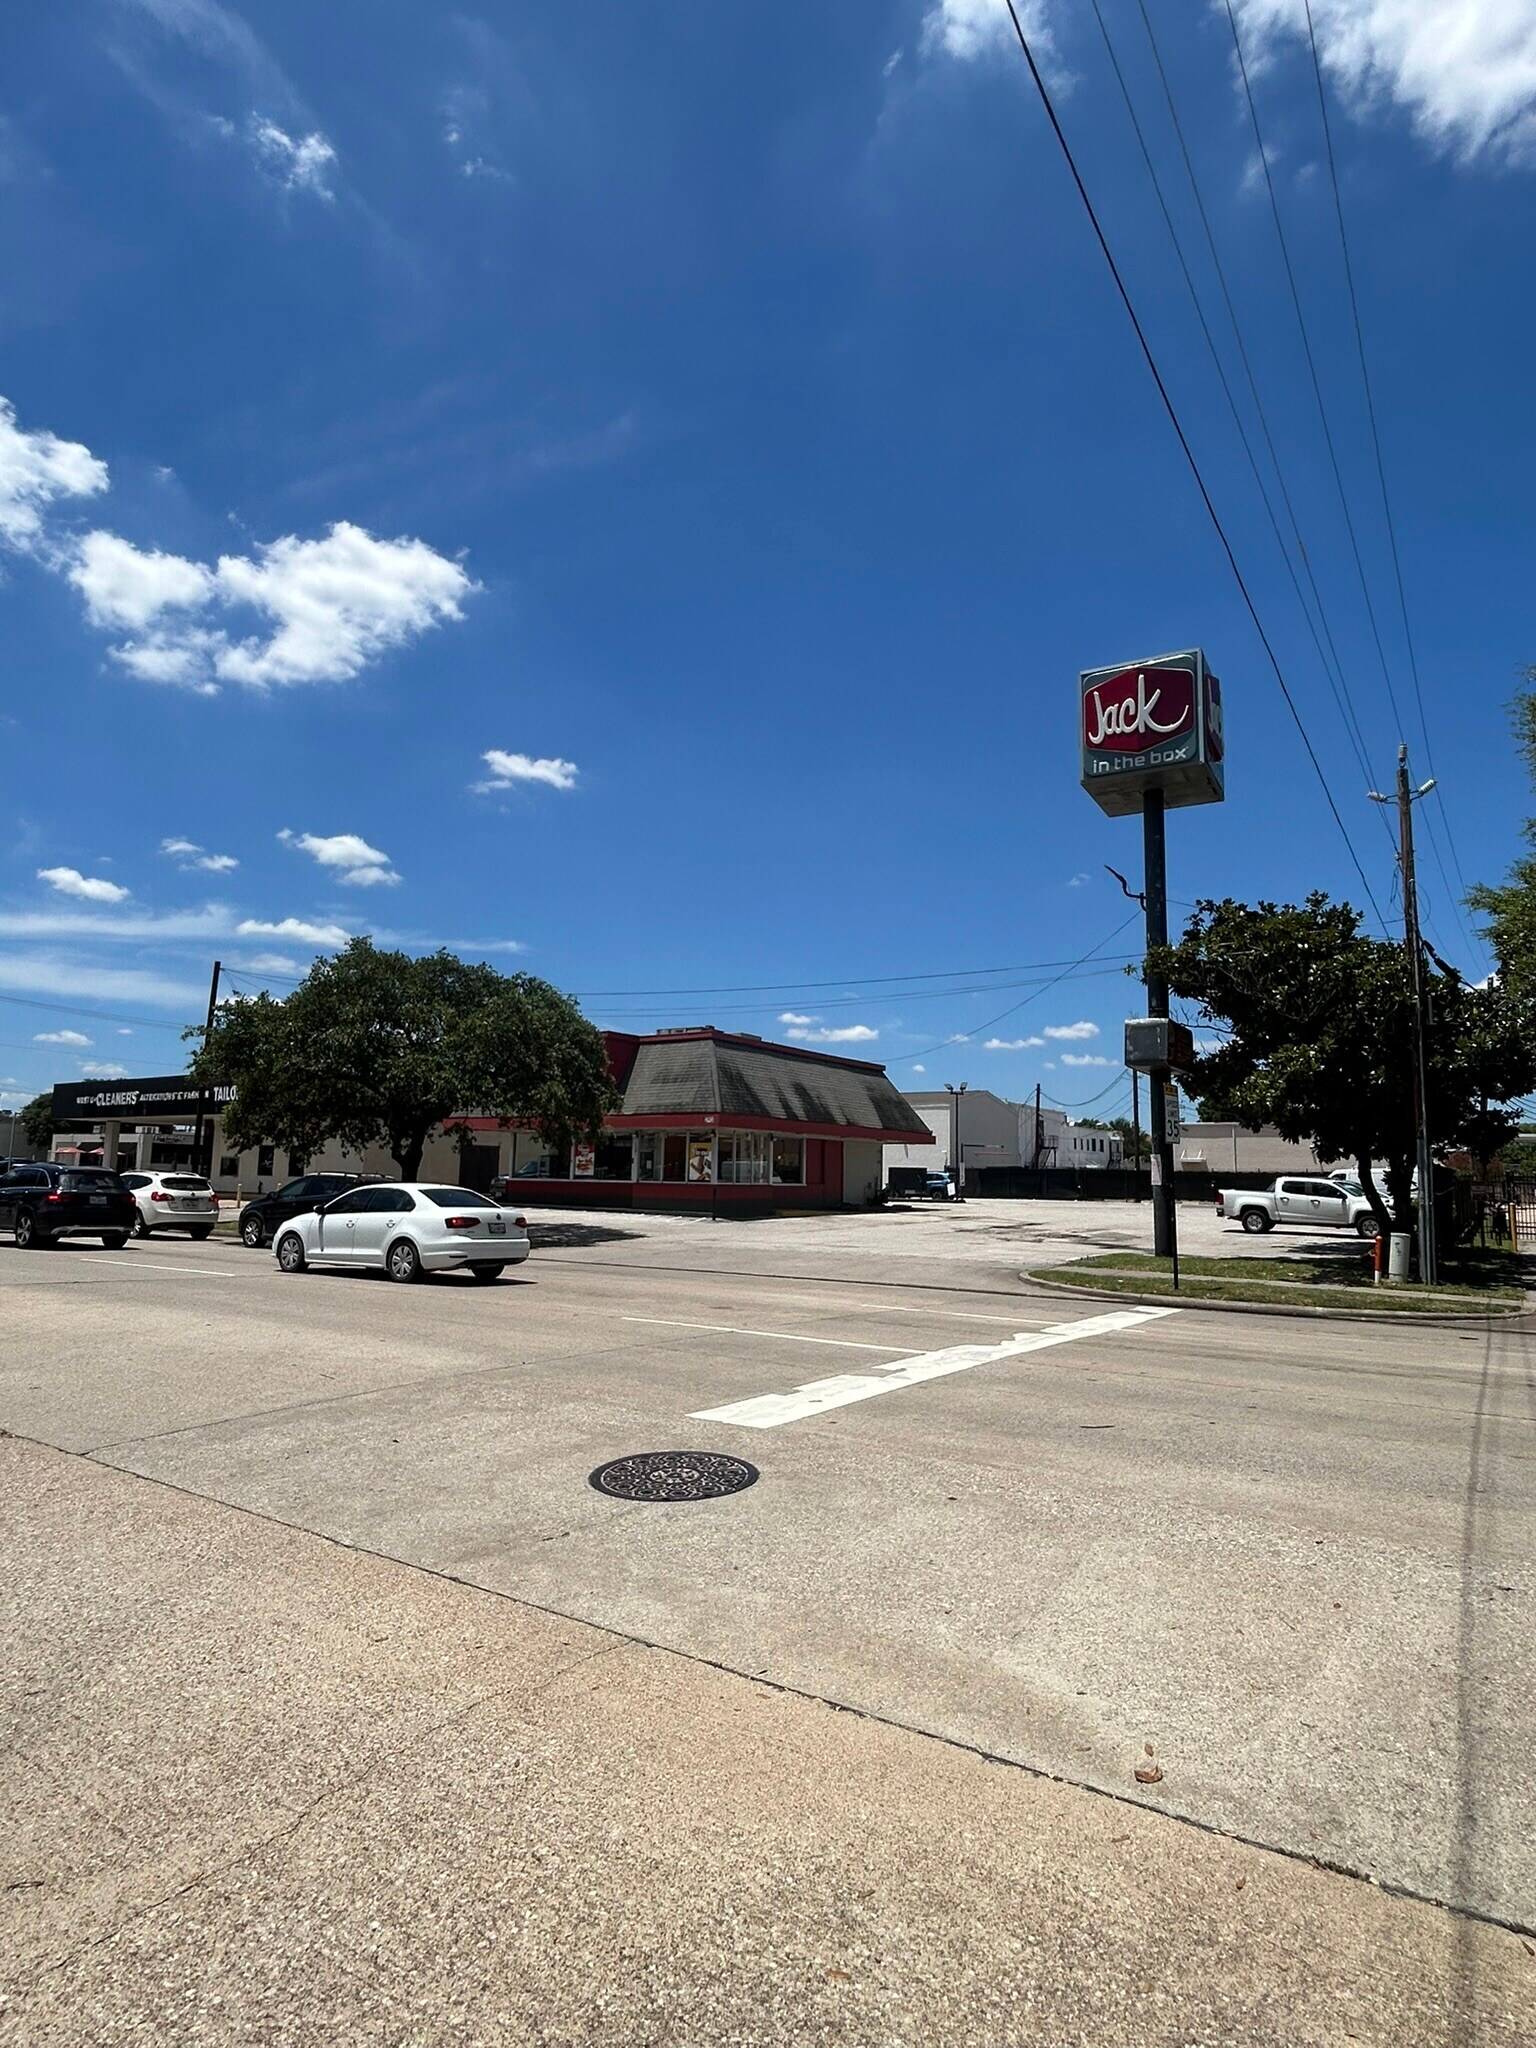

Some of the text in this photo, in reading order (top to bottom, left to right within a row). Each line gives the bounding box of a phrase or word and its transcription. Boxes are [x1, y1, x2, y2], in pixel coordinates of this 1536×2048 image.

[1088, 674, 1189, 744] Jack
[1093, 747, 1187, 774] in the box
[95, 1090, 140, 1106] CLEANERS
[1167, 1119, 1180, 1137] 35
